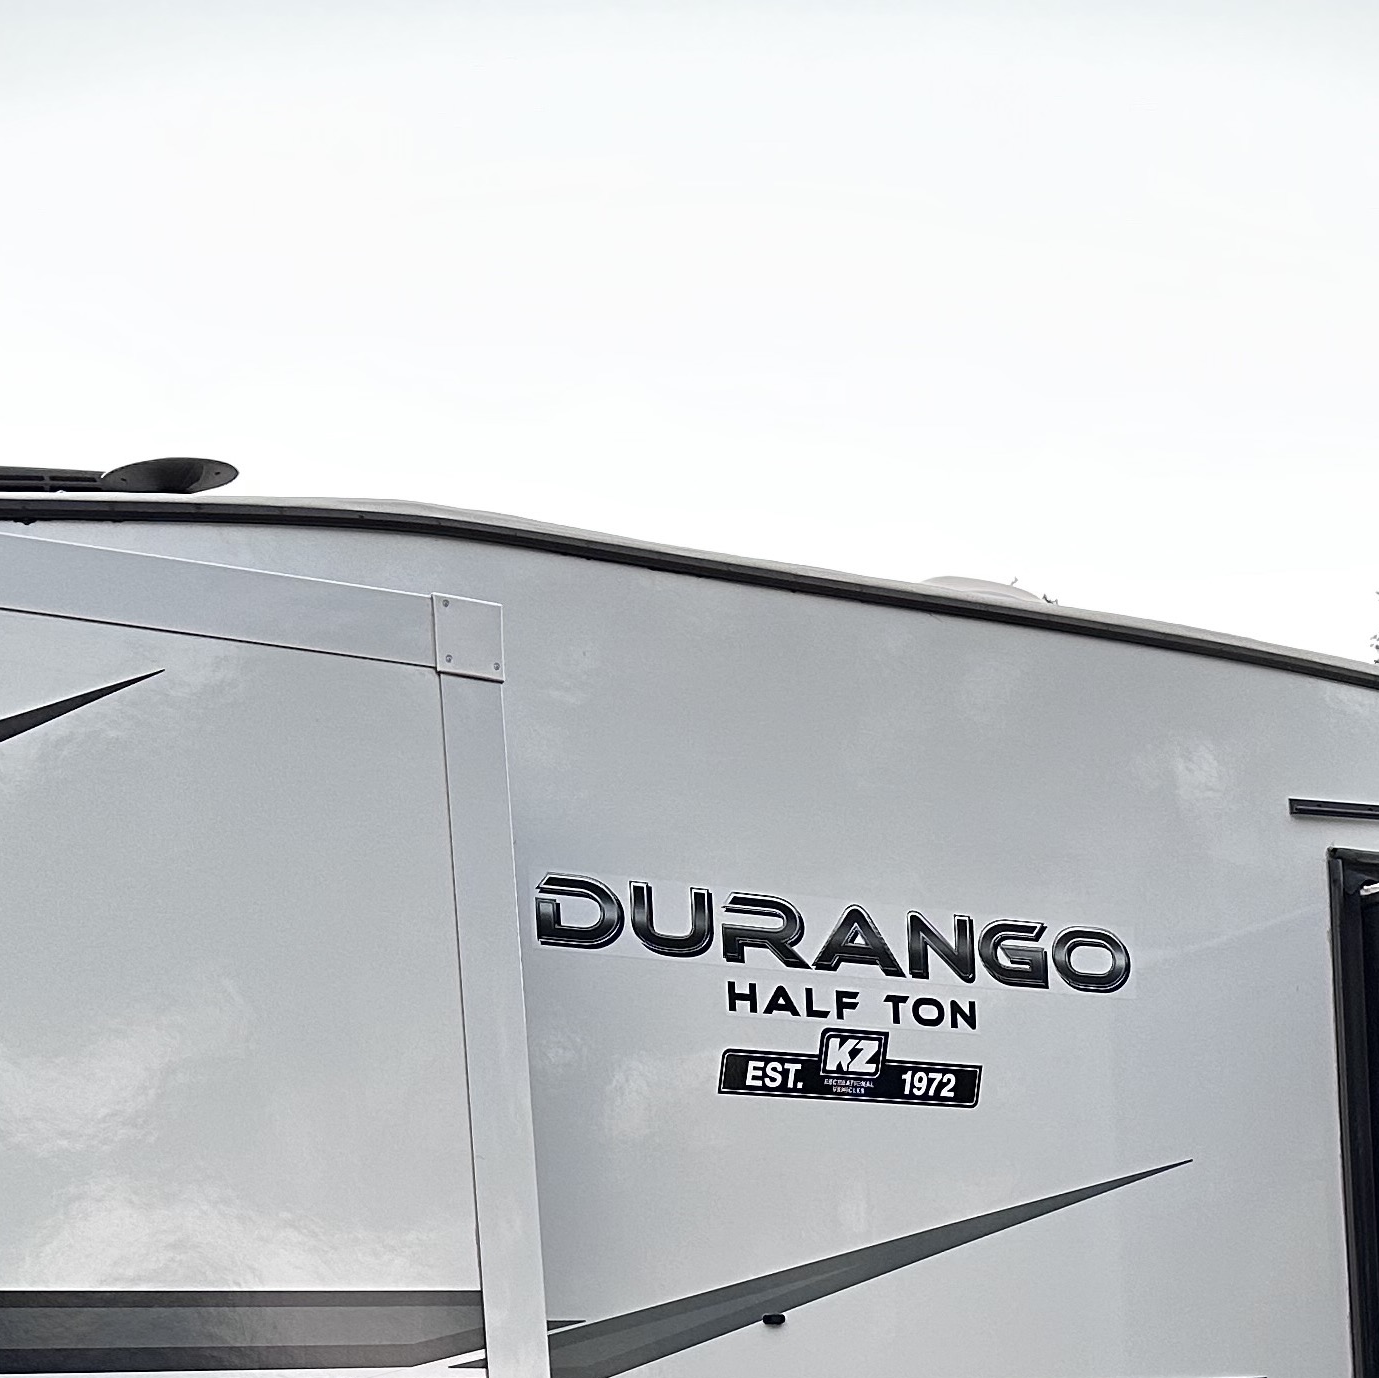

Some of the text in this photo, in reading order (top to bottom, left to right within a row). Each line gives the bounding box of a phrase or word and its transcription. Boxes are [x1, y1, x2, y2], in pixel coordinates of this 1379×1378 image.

[534, 872, 1132, 993] DURANGO
[727, 980, 977, 1031] HALF TON
[826, 1037, 879, 1073] KZ
[745, 1061, 803, 1090] EST.
[902, 1070, 956, 1098] 1972
